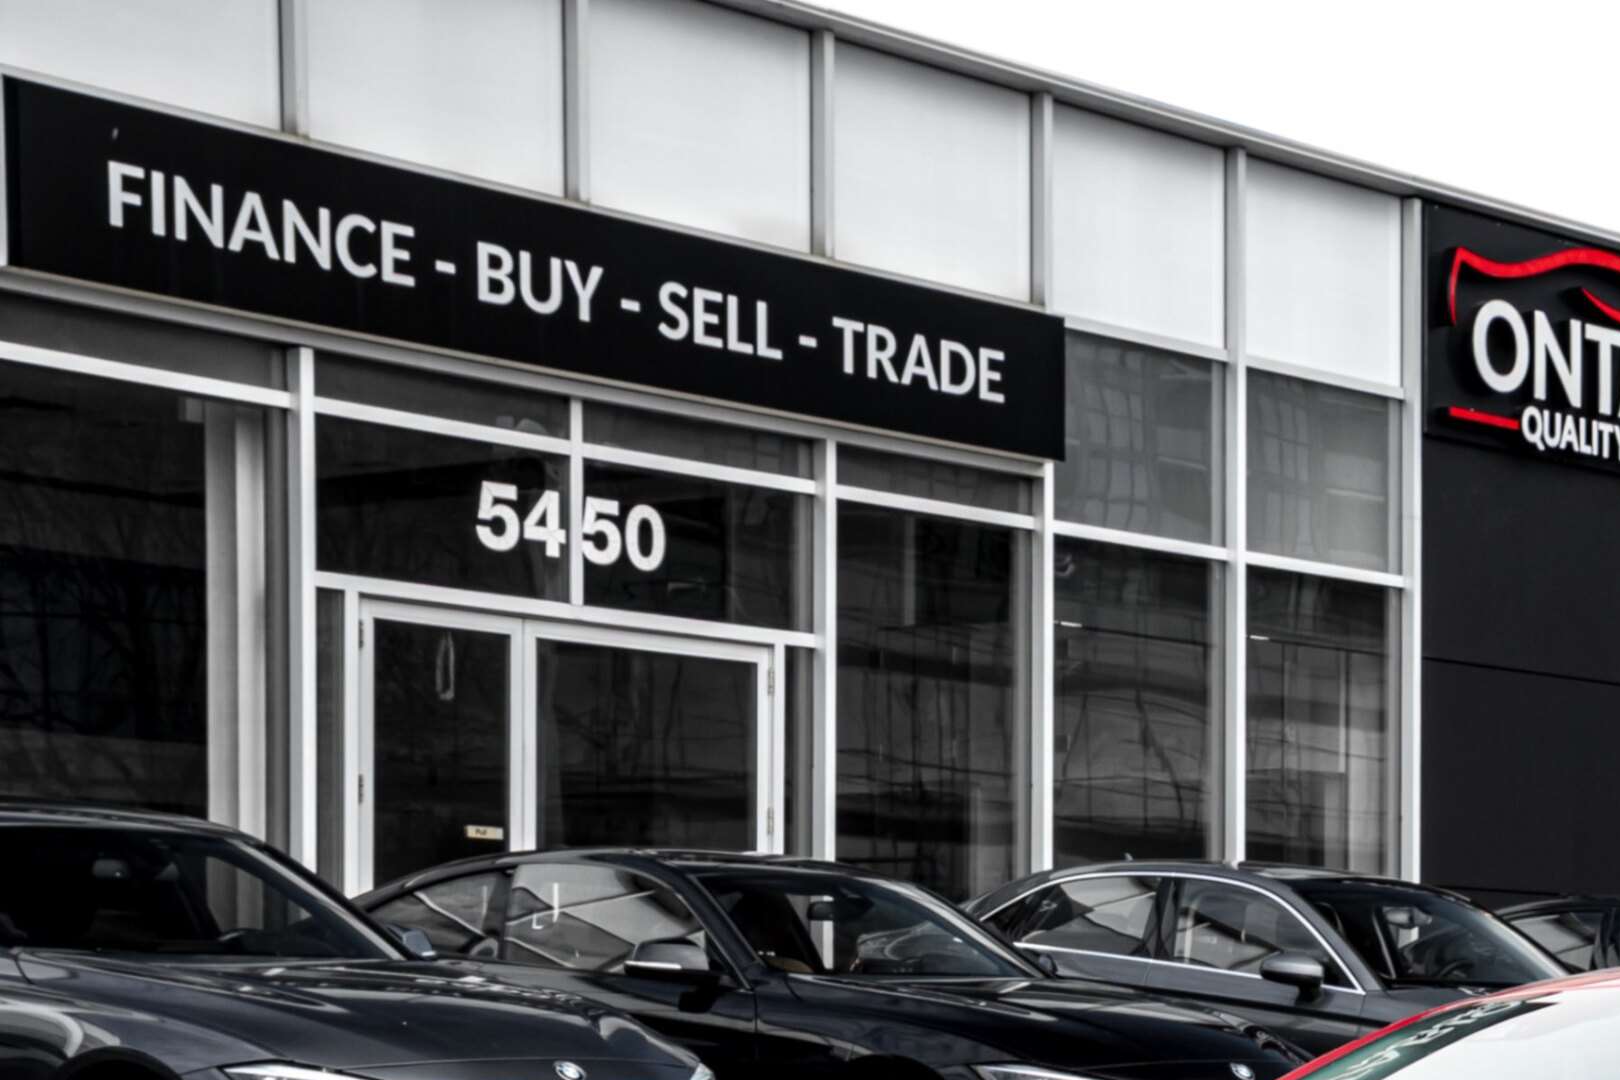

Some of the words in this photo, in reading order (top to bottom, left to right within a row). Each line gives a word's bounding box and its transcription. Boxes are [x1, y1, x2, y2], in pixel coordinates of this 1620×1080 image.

[108, 160, 416, 288] FINANCE
[477, 241, 604, 322] BUY
[658, 281, 783, 360] SELL
[832, 316, 1006, 405] TRADE
[475, 480, 666, 572] 5450
